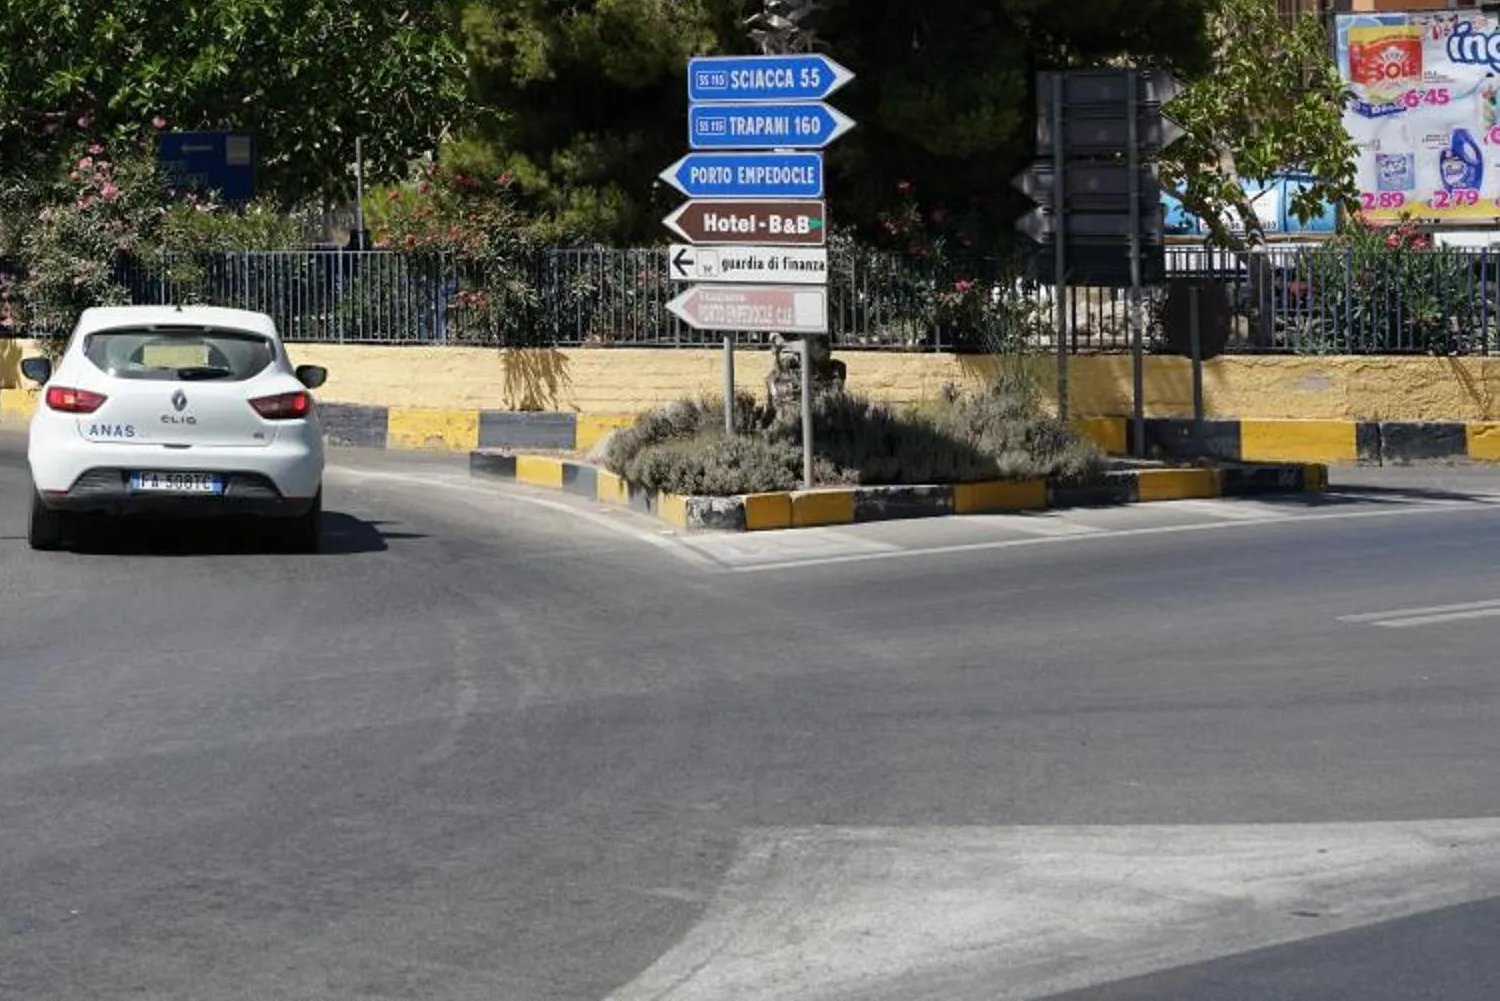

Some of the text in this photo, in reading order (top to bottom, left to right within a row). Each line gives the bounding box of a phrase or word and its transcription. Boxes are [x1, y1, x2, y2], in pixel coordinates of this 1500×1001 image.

[730, 70, 794, 89] SCIACCA
[801, 68, 821, 87] 55
[729, 116, 789, 135] TRAPANI
[794, 116, 821, 135] 160
[691, 166, 815, 184] PORTO EMPEDOCLE
[721, 255, 825, 272] guardia di finanza
[160, 414, 197, 425] CLIO
[89, 424, 136, 438] ANAS
